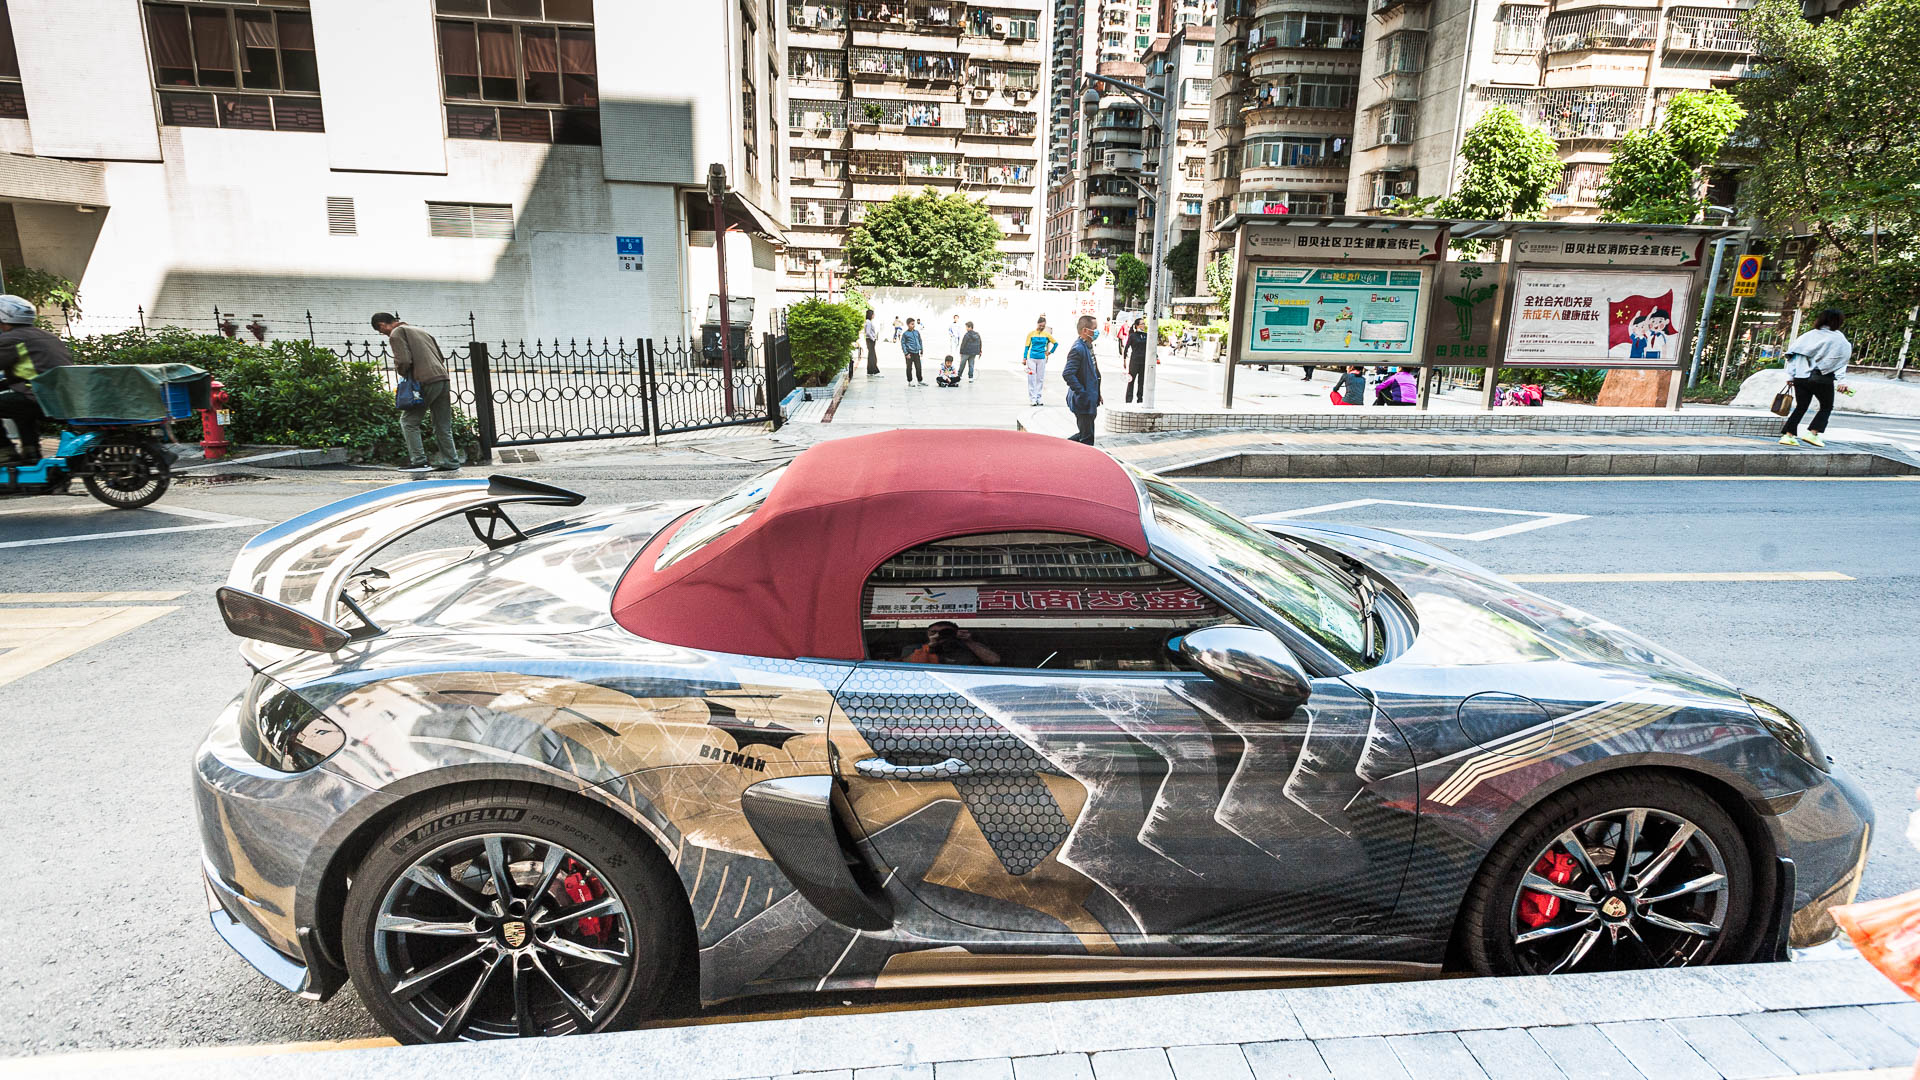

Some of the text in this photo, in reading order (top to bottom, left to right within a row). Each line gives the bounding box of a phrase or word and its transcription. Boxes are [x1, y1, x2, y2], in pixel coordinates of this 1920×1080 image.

[1297, 236, 1420, 250] 田贝社区卫生健康宣传栏
[1564, 243, 1682, 257] 田贝社区消防安全宣传栏
[625, 262, 631, 270] 8
[1523, 295, 1593, 308] 全社会关心关爱
[1522, 309, 1600, 321] 未成年人健康成长
[1436, 344, 1489, 358] 田贝社区
[699, 744, 767, 773] BATMAN
[416, 807, 521, 840] MICHELIN
[531, 814, 561, 827] PILOT
[562, 825, 596, 844] SPORT
